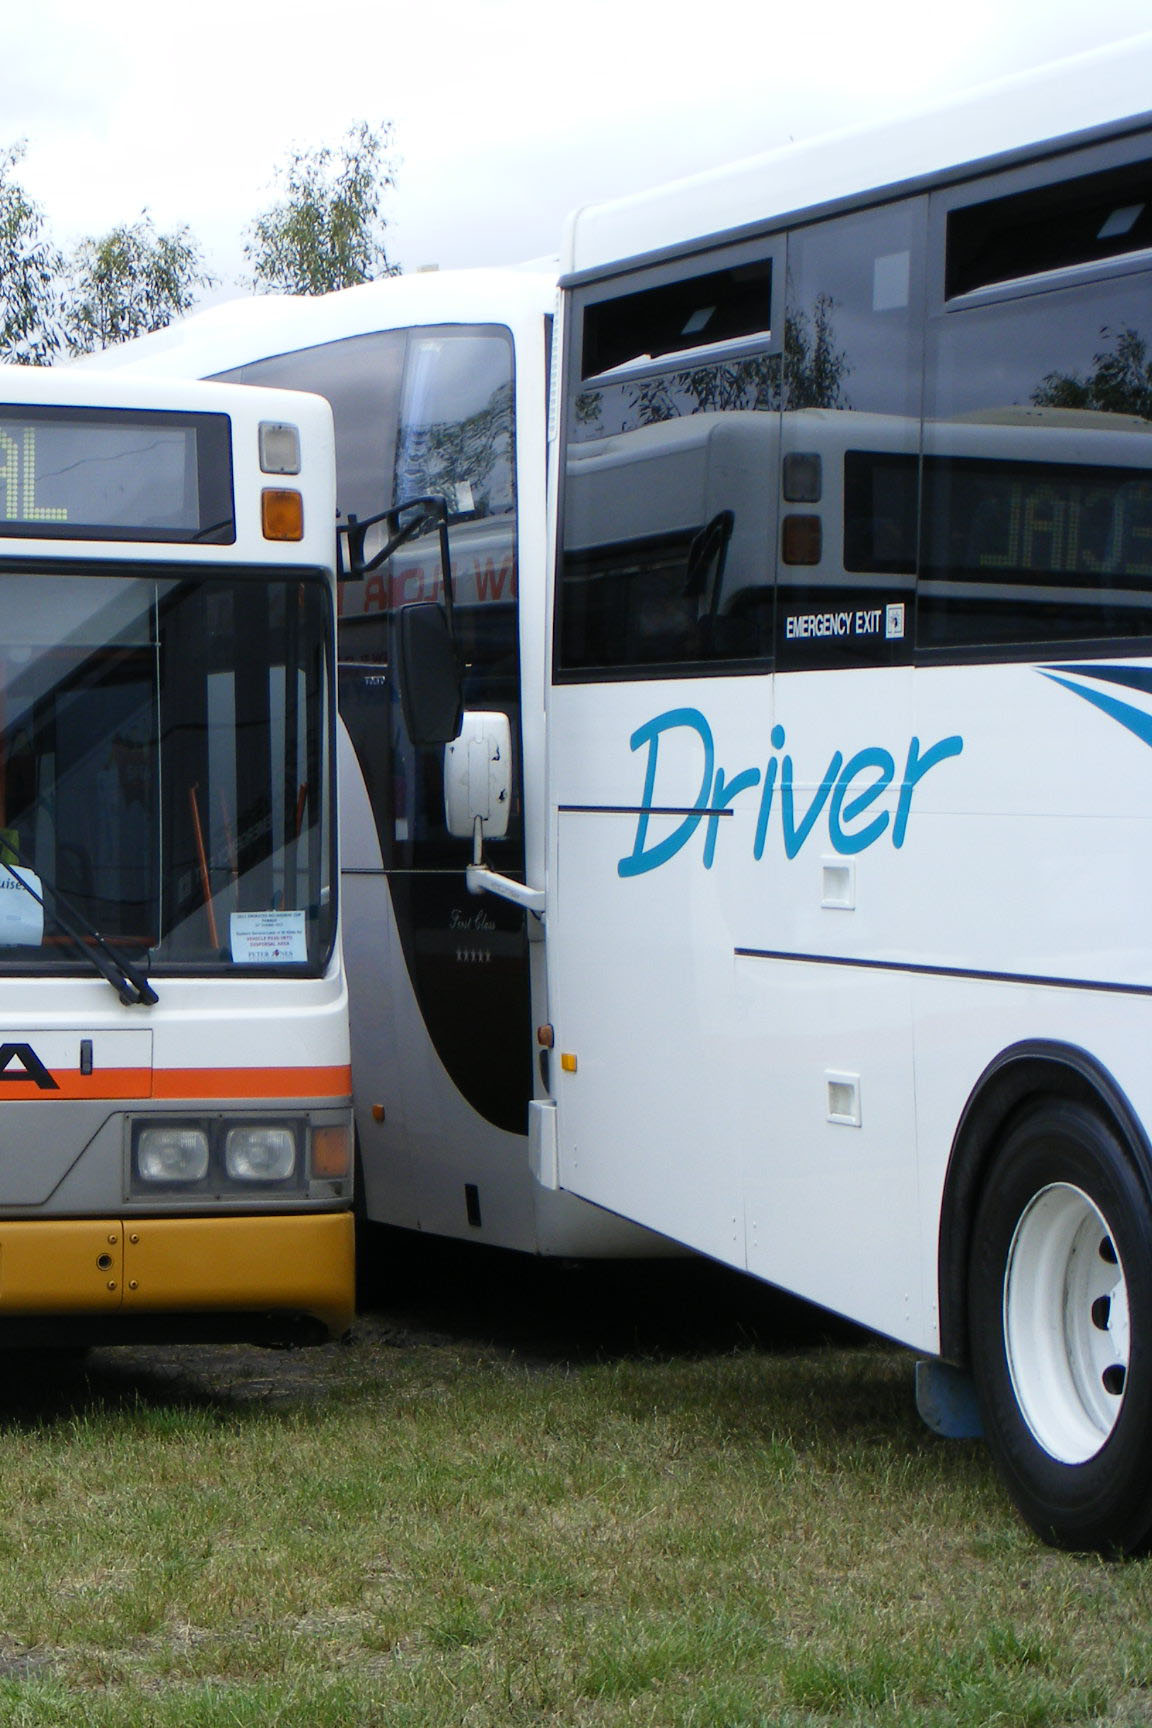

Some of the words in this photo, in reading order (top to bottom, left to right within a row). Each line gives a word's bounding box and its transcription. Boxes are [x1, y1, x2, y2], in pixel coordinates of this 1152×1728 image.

[786, 612, 853, 639] EMERGENCY
[855, 609, 882, 635] EXIT
[617, 707, 964, 878] Driver
